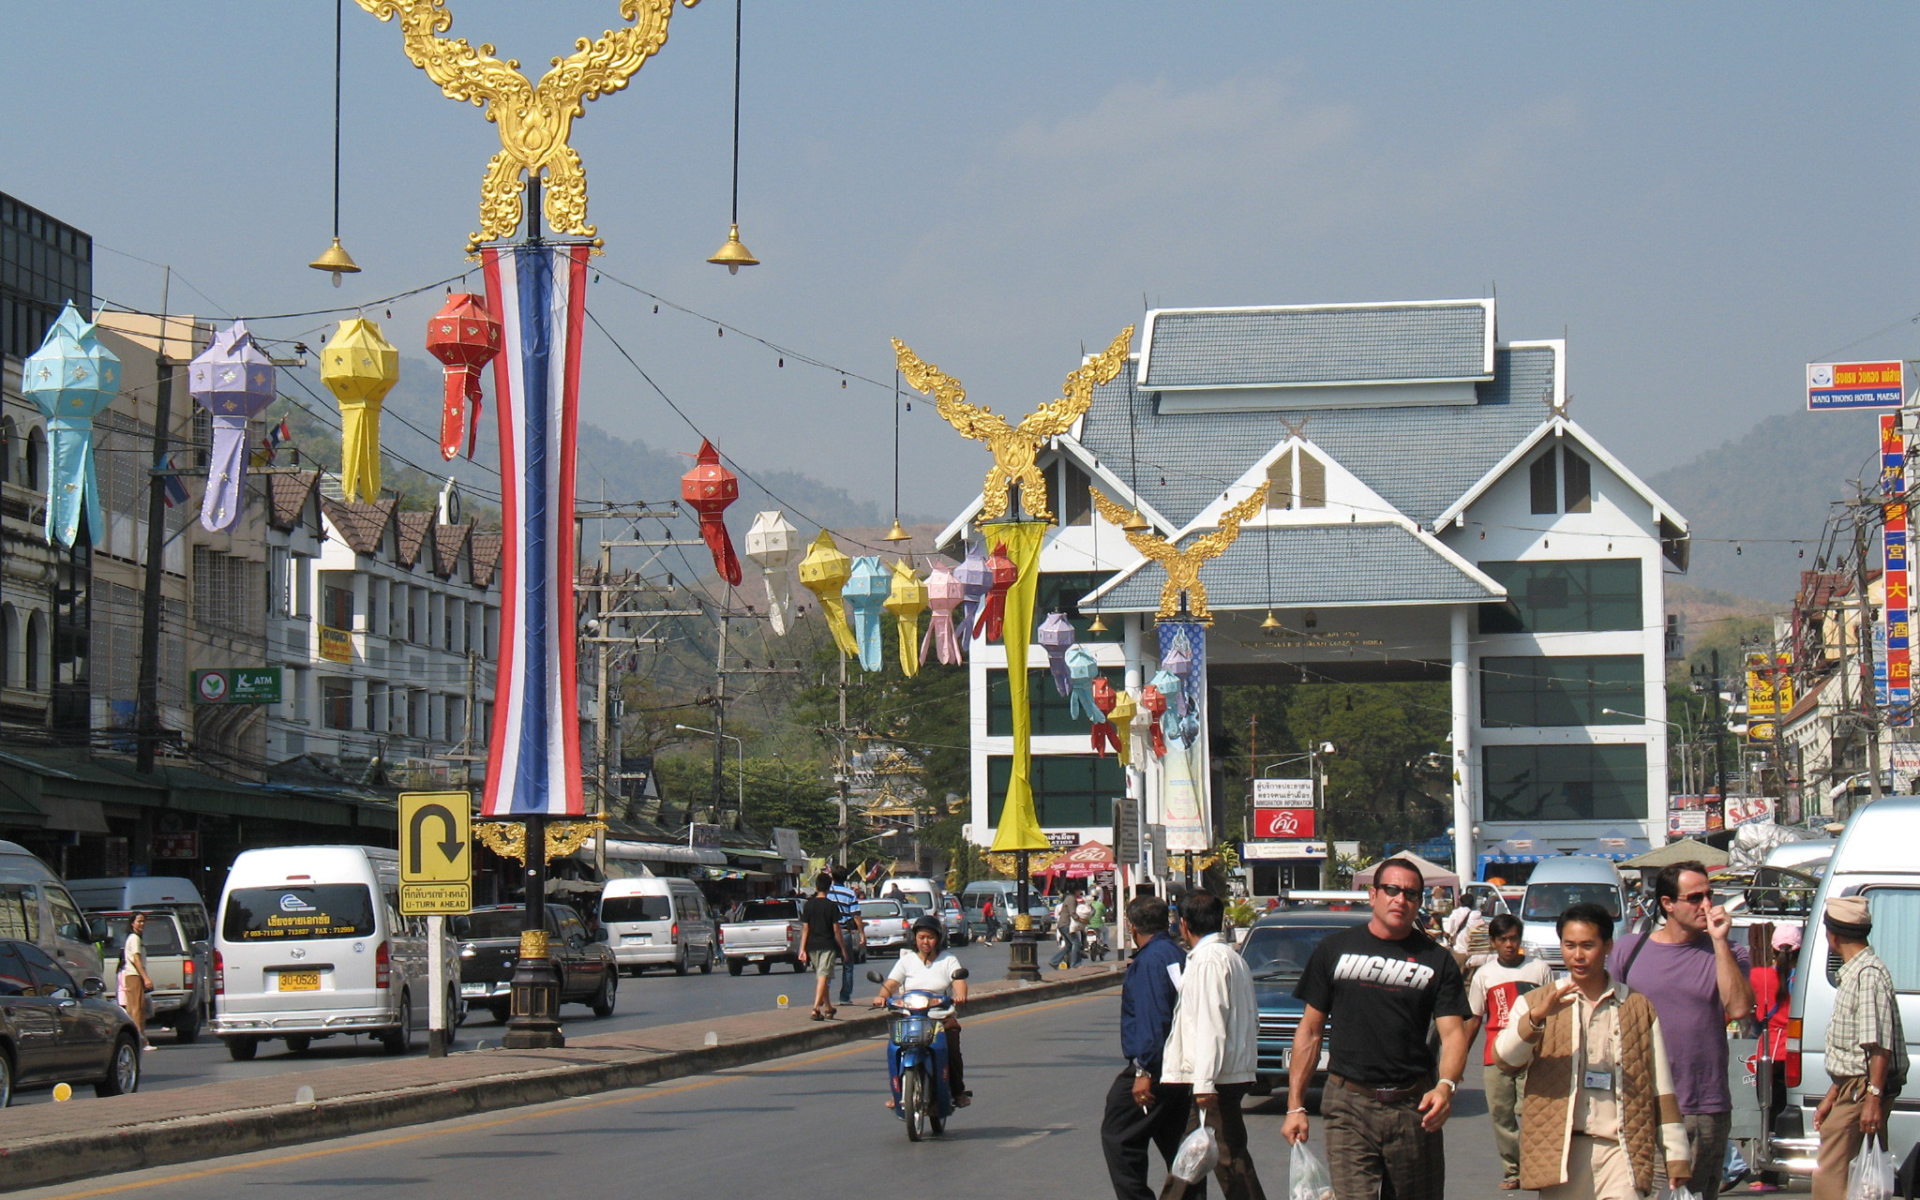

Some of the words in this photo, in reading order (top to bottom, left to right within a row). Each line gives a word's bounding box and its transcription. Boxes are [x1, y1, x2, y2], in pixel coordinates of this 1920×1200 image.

[1811, 395, 1831, 403] WANG
[1831, 394, 1853, 402] THONG
[1854, 393, 1875, 402] HOTEL
[1876, 392, 1900, 401] MAESAI
[237, 673, 252, 688] K
[254, 676, 273, 685] ATM
[1752, 692, 1788, 702] Kodk
[404, 887, 468, 899] ที่กลับรถข้างหน้า
[440, 900, 466, 908] AHEAD
[267, 912, 331, 927] เชียงรายเอกชัย
[315, 927, 328, 935] FAX
[1333, 953, 1435, 991] HIGHER
[281, 974, 318, 986] 30-0528
